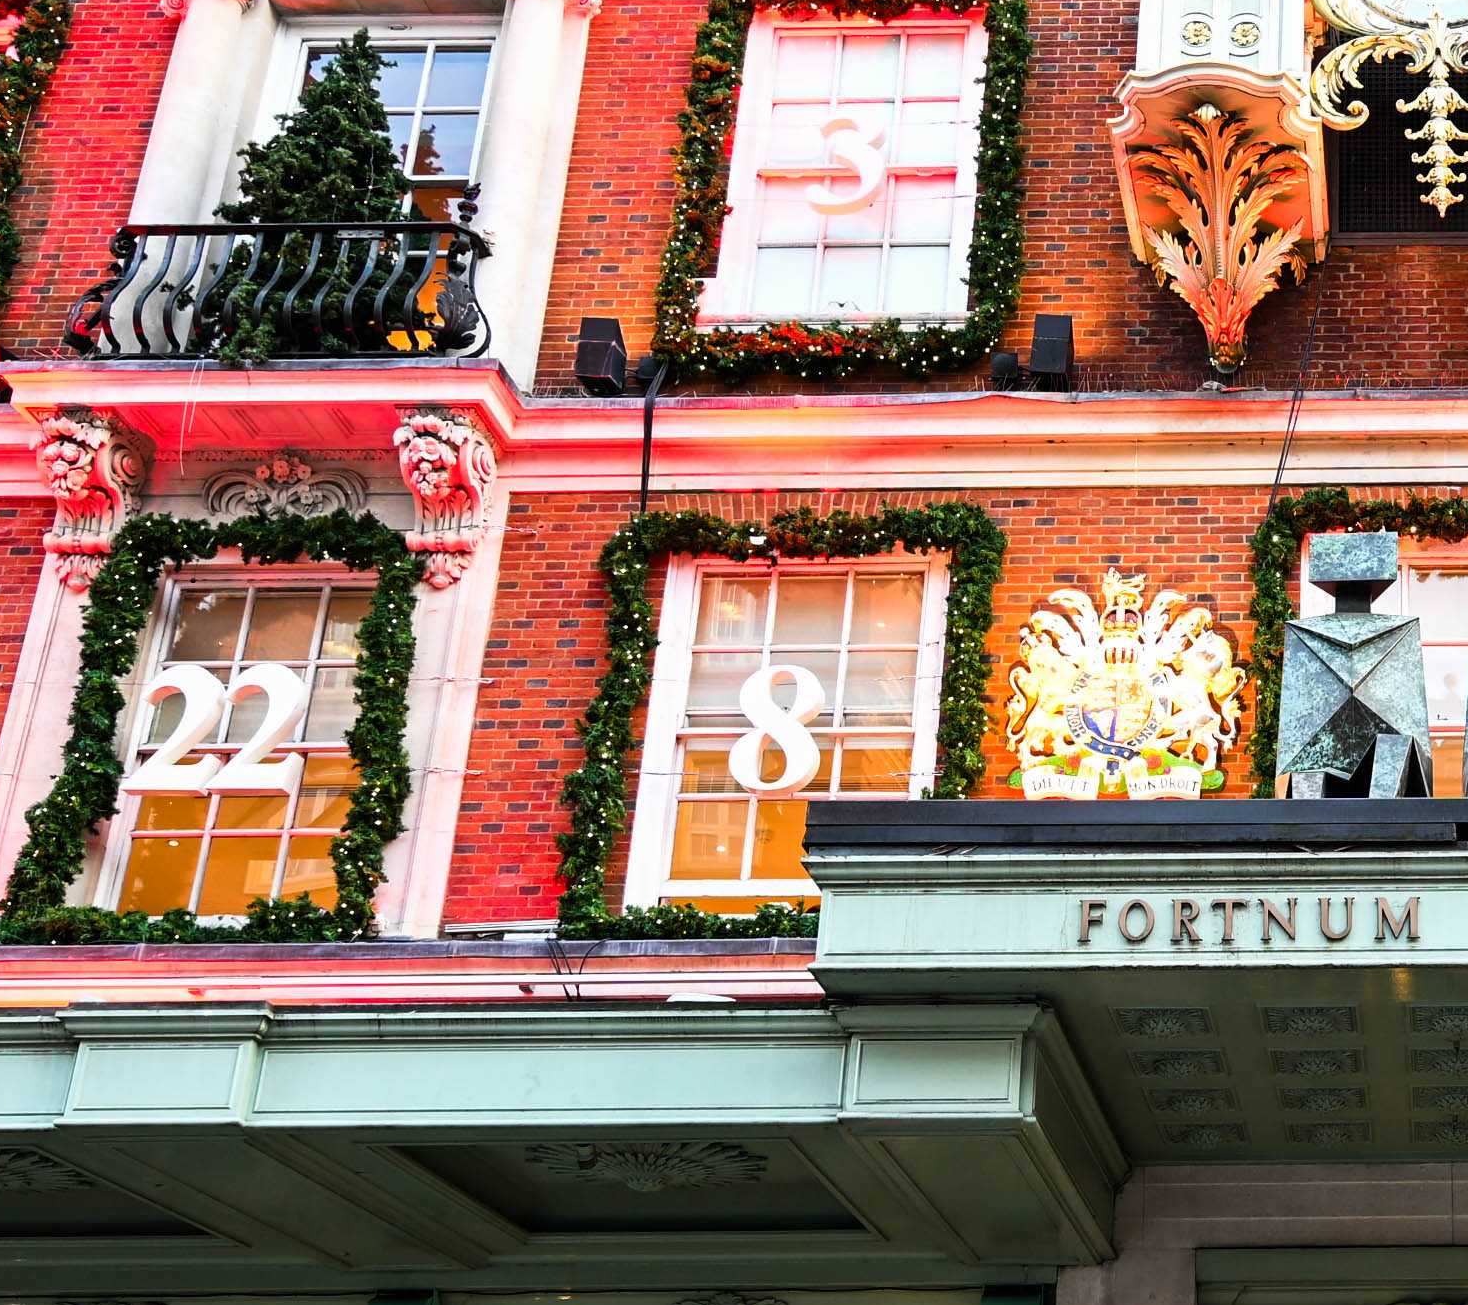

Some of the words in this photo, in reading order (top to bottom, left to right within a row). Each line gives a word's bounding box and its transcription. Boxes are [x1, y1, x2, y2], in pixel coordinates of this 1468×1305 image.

[807, 116, 886, 216] 3
[123, 662, 305, 797] 22
[730, 665, 824, 795] 8
[1077, 896, 1421, 943] FORTNUM
